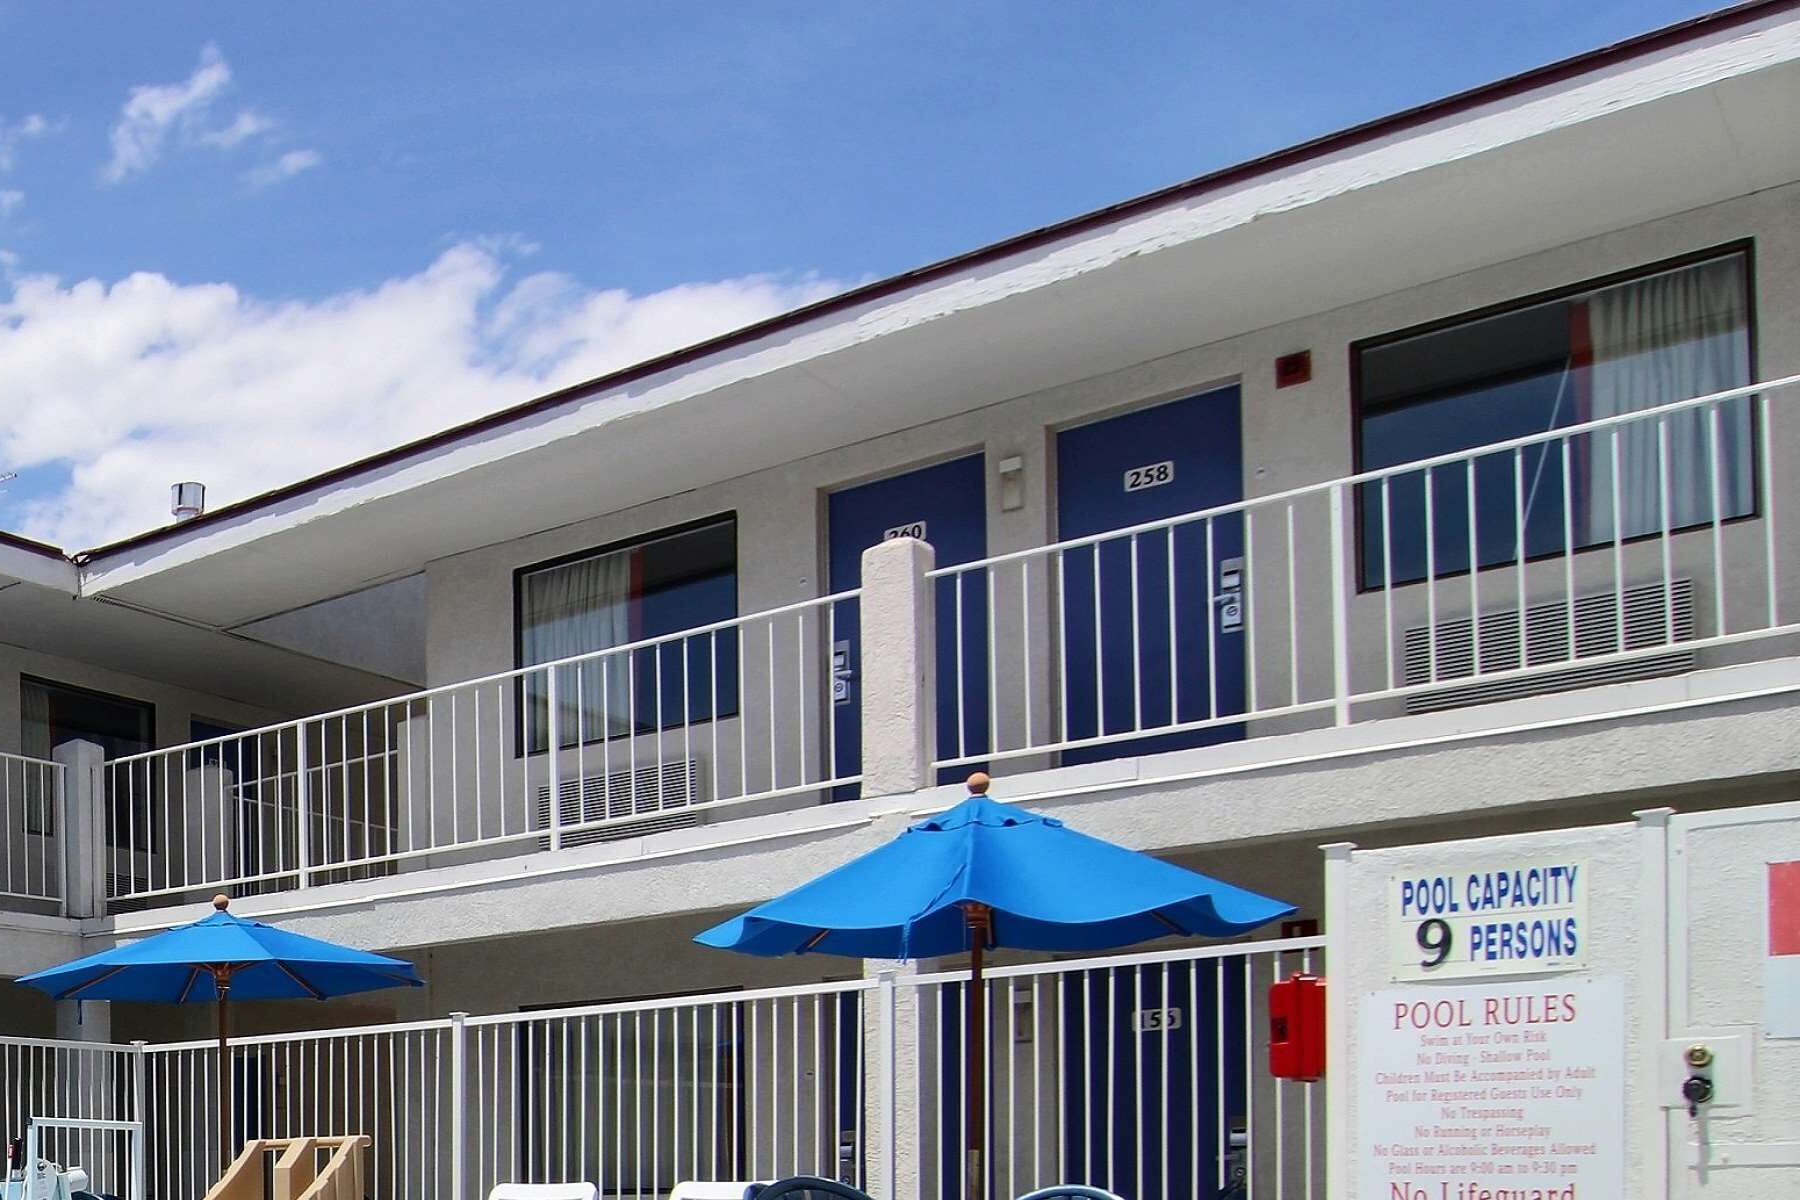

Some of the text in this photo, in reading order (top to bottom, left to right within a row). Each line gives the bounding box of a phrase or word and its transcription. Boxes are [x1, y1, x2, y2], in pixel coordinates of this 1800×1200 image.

[1130, 465, 1169, 488] 258
[1402, 865, 1578, 916] POOL CAPACITY
[1417, 917, 1577, 968] 9 PERSONS
[1394, 993, 1576, 1029] POOL RULES
[1421, 1030, 1546, 1046] Swim at Your Own Risk
[1417, 1053, 1432, 1064] No
[1435, 1052, 1470, 1065] Diving
[1480, 1050, 1522, 1062] Shallow
[1527, 1048, 1551, 1060] Pool
[1376, 1066, 1596, 1084] Children Must Be Accompanied by Adult
[1387, 1085, 1583, 1104] Pool for Registered Guests Use Only
[1441, 1105, 1524, 1121] No Trespassing
[1415, 1125, 1430, 1137] No
[1433, 1125, 1477, 1140] Running
[1496, 1124, 1552, 1139] Horseplay
[1374, 1144, 1388, 1156] No
[1392, 1144, 1419, 1156] Glass
[1438, 1143, 1488, 1156] Alcoholic
[1491, 1143, 1545, 1158] Beverages
[1550, 1142, 1597, 1154] Allowed
[1389, 1162, 1411, 1174] Pool
[1415, 1162, 1446, 1174] Hours
[1517, 1163, 1529, 1173] to
